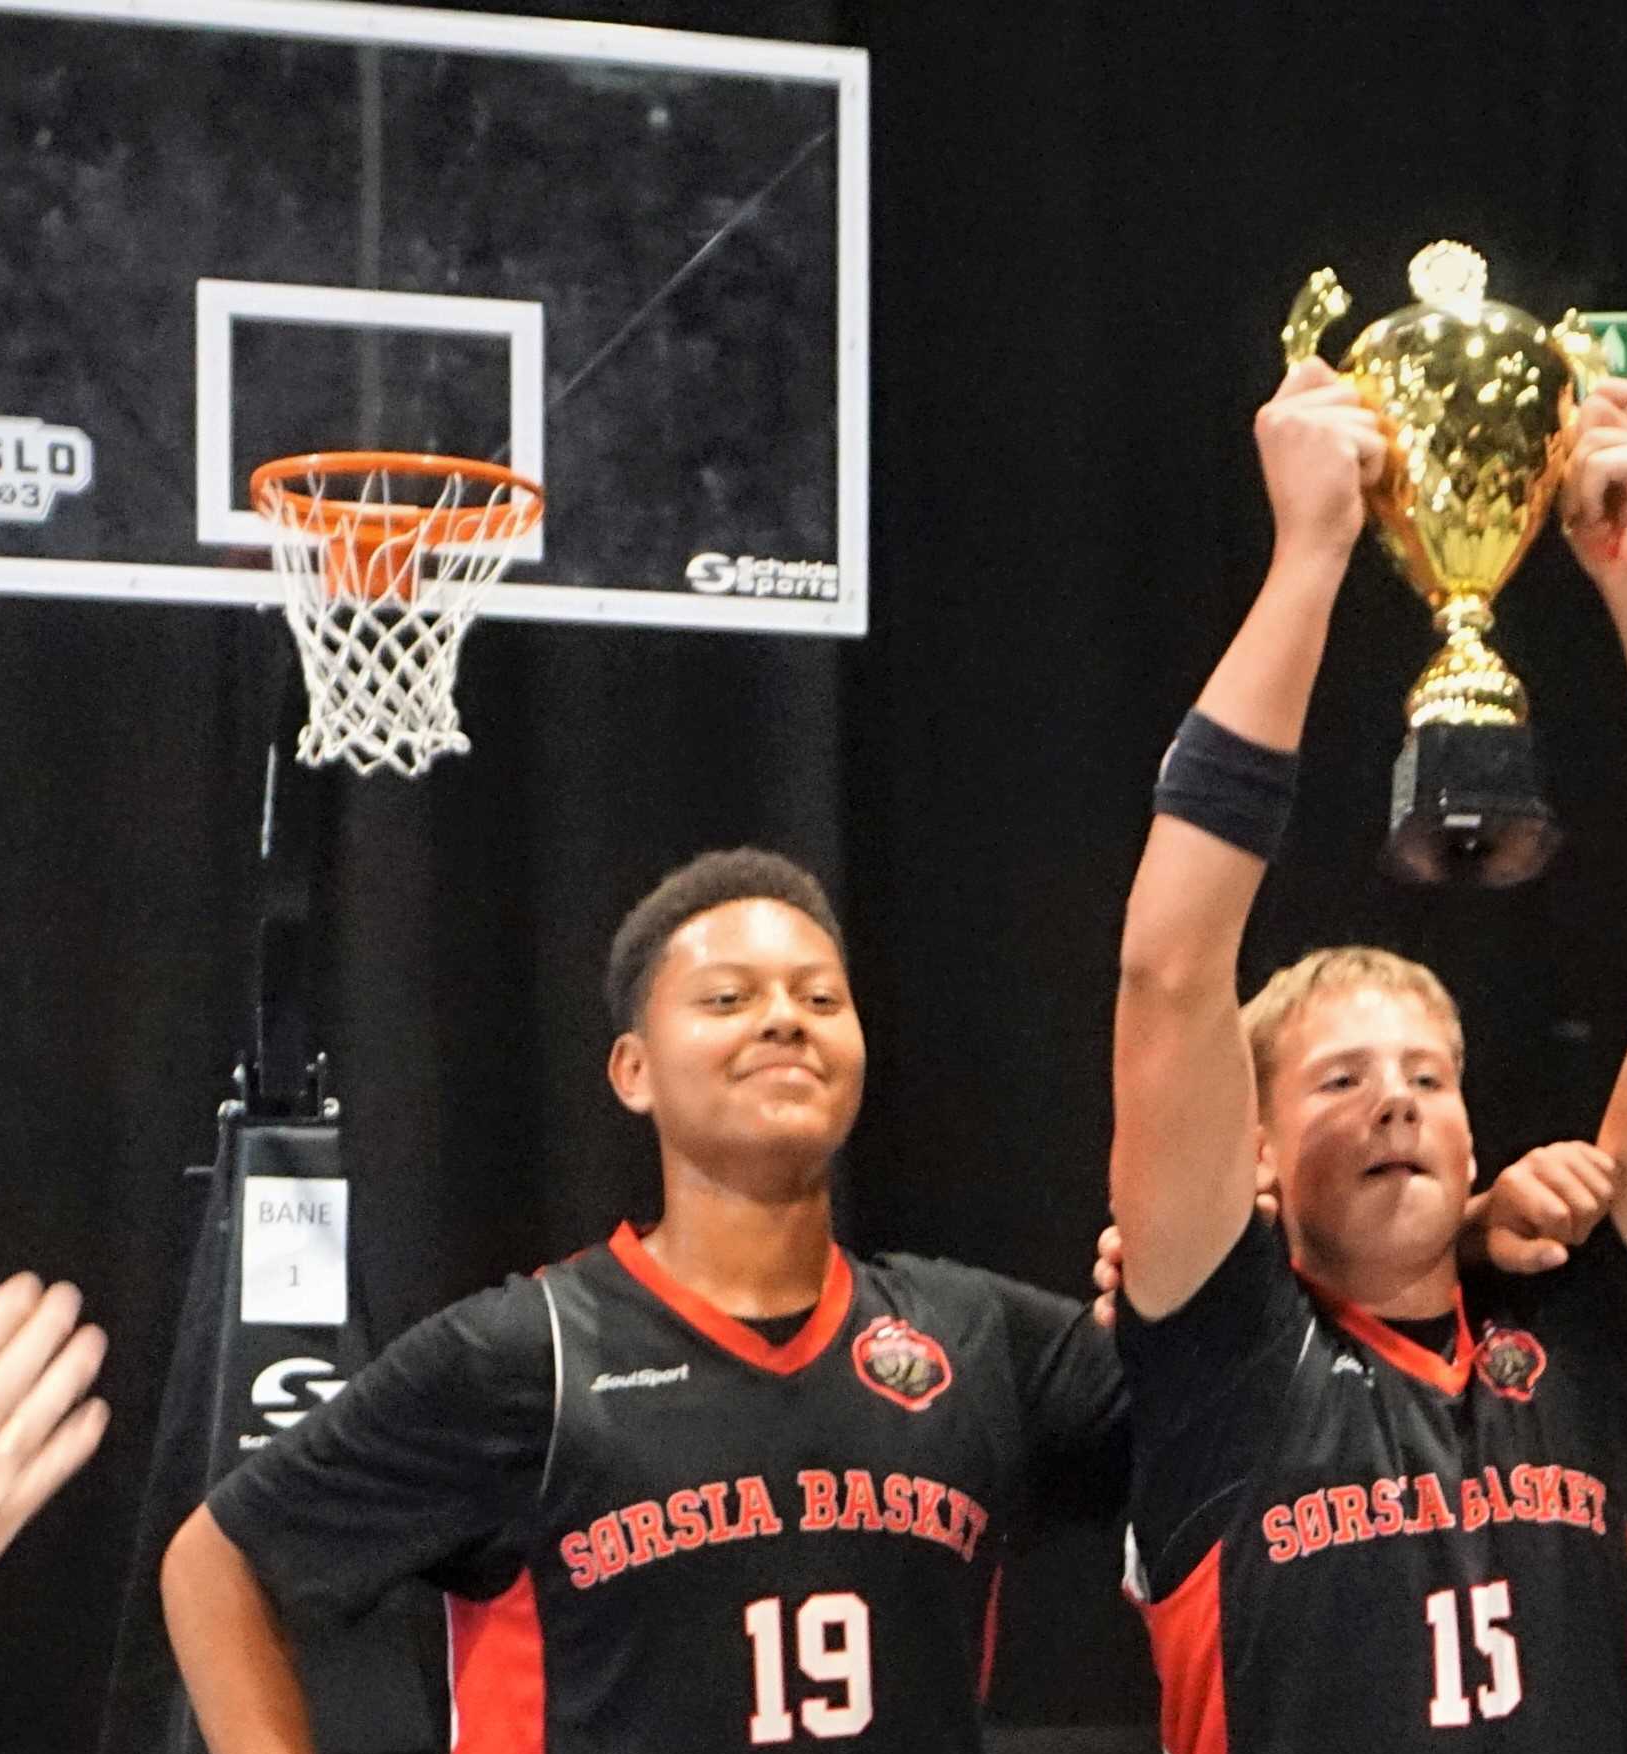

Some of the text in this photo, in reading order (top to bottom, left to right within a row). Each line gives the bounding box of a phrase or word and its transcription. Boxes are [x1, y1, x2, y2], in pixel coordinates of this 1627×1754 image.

[735, 572, 839, 598] Sports
[259, 1202, 333, 1226] BANE
[287, 1265, 302, 1287] 1
[560, 1475, 783, 1590] SØRSIA
[743, 1592, 874, 1745] 19
[1425, 1578, 1523, 1728] 15
